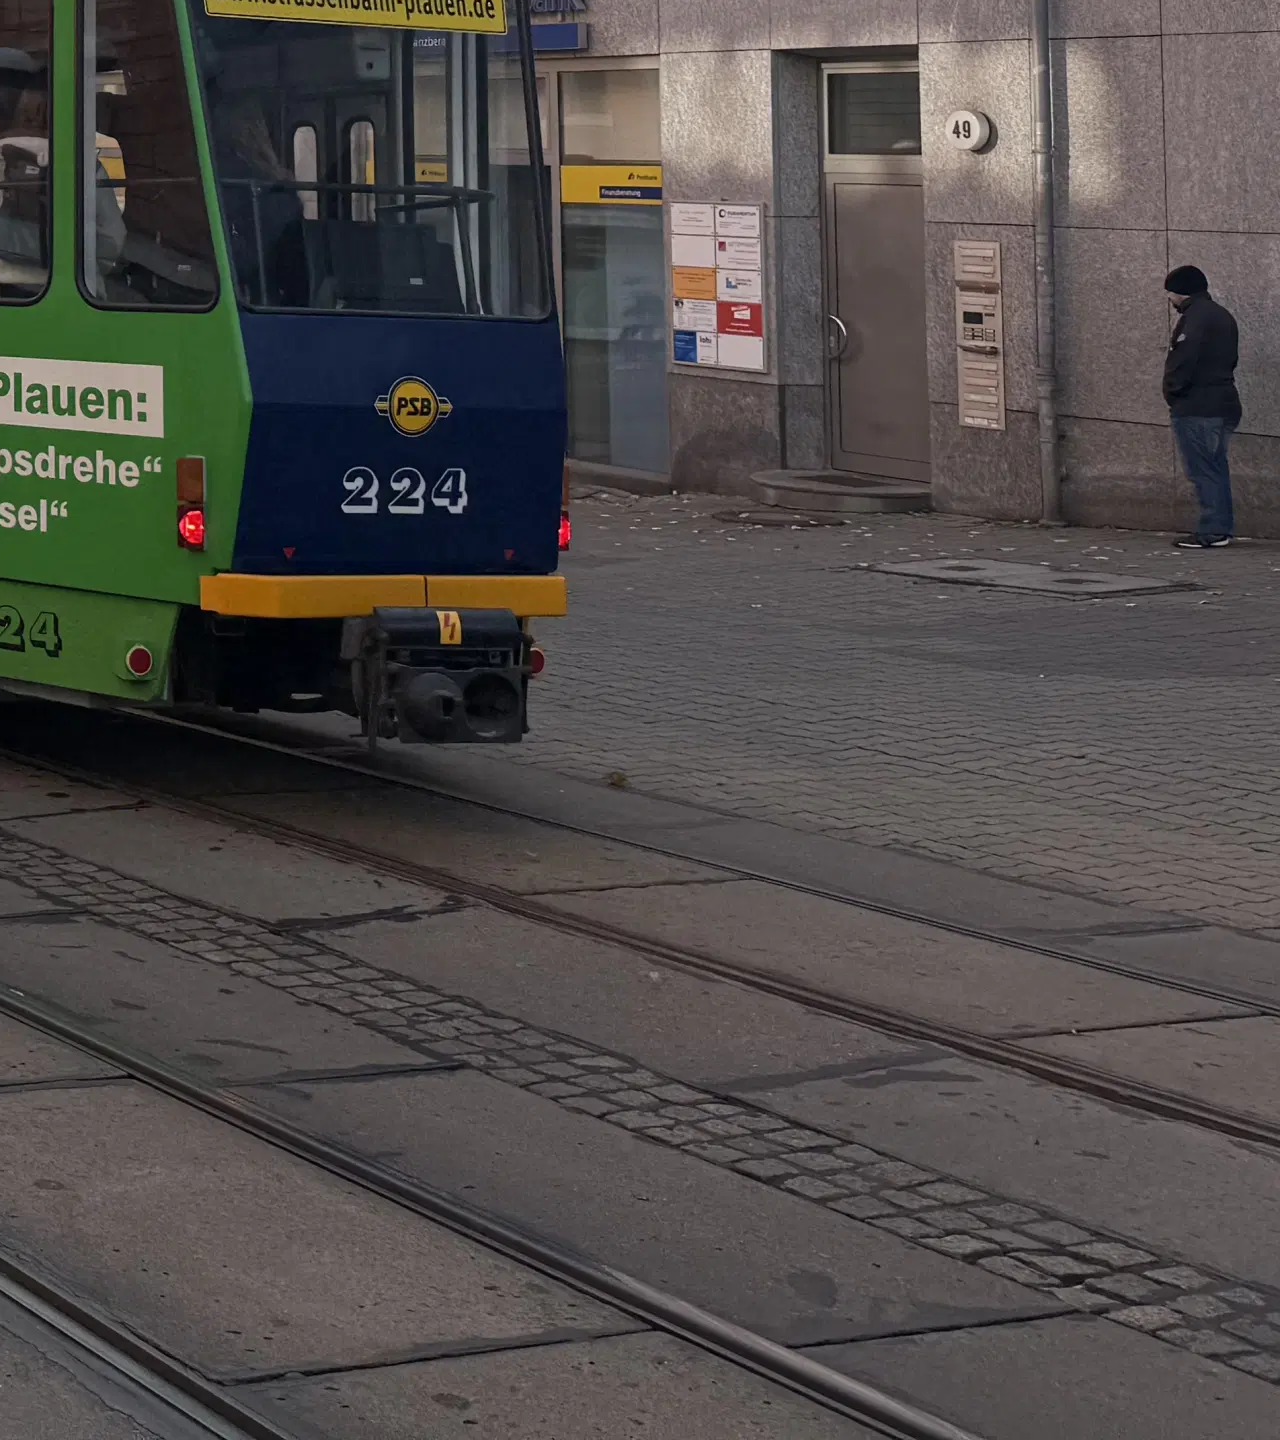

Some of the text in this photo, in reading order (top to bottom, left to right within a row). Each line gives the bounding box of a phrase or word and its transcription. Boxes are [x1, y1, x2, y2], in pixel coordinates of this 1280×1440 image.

[952, 120, 971, 139] 49
[396, 397, 432, 416] PSB
[341, 466, 468, 514] 224
